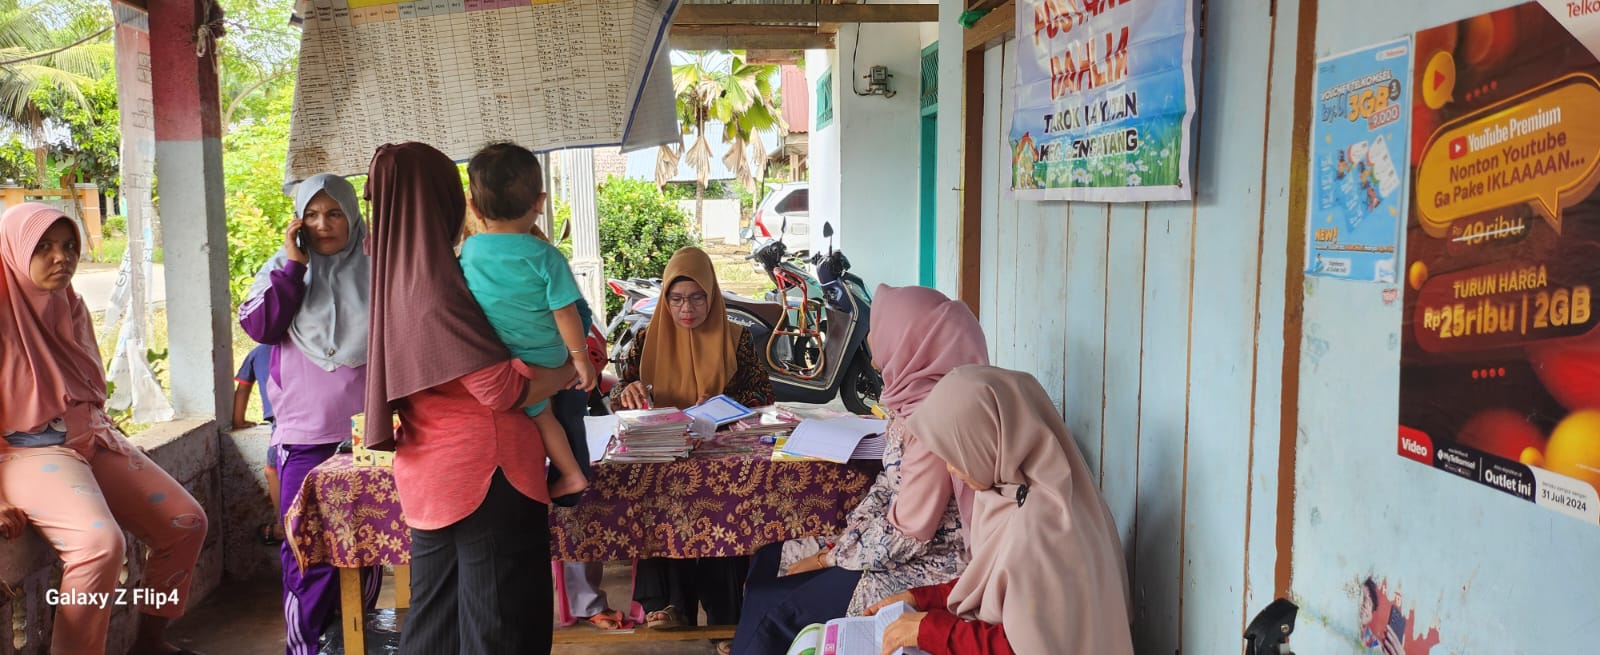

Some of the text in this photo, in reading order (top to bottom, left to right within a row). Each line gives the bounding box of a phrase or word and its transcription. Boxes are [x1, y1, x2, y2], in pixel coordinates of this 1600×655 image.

[1050, 26, 1128, 100] DAHLIA
[1044, 107, 1081, 133] TAROK
[1349, 85, 1389, 122] 3GB
[1467, 106, 1561, 153] YouTube Premium
[1450, 131, 1567, 183] Nonton Youtube
[1434, 191, 1450, 208] Ga
[1453, 182, 1484, 203] Pake
[1453, 265, 1547, 299] TURUN HARGA
[1533, 285, 1591, 328] 2GB
[1401, 436, 1427, 457] Video
[1484, 469, 1517, 491] Outlet
[1518, 480, 1531, 497] ini
[1541, 488, 1550, 500] 31
[1551, 492, 1565, 505] Juli
[1566, 496, 1587, 512] 2024
